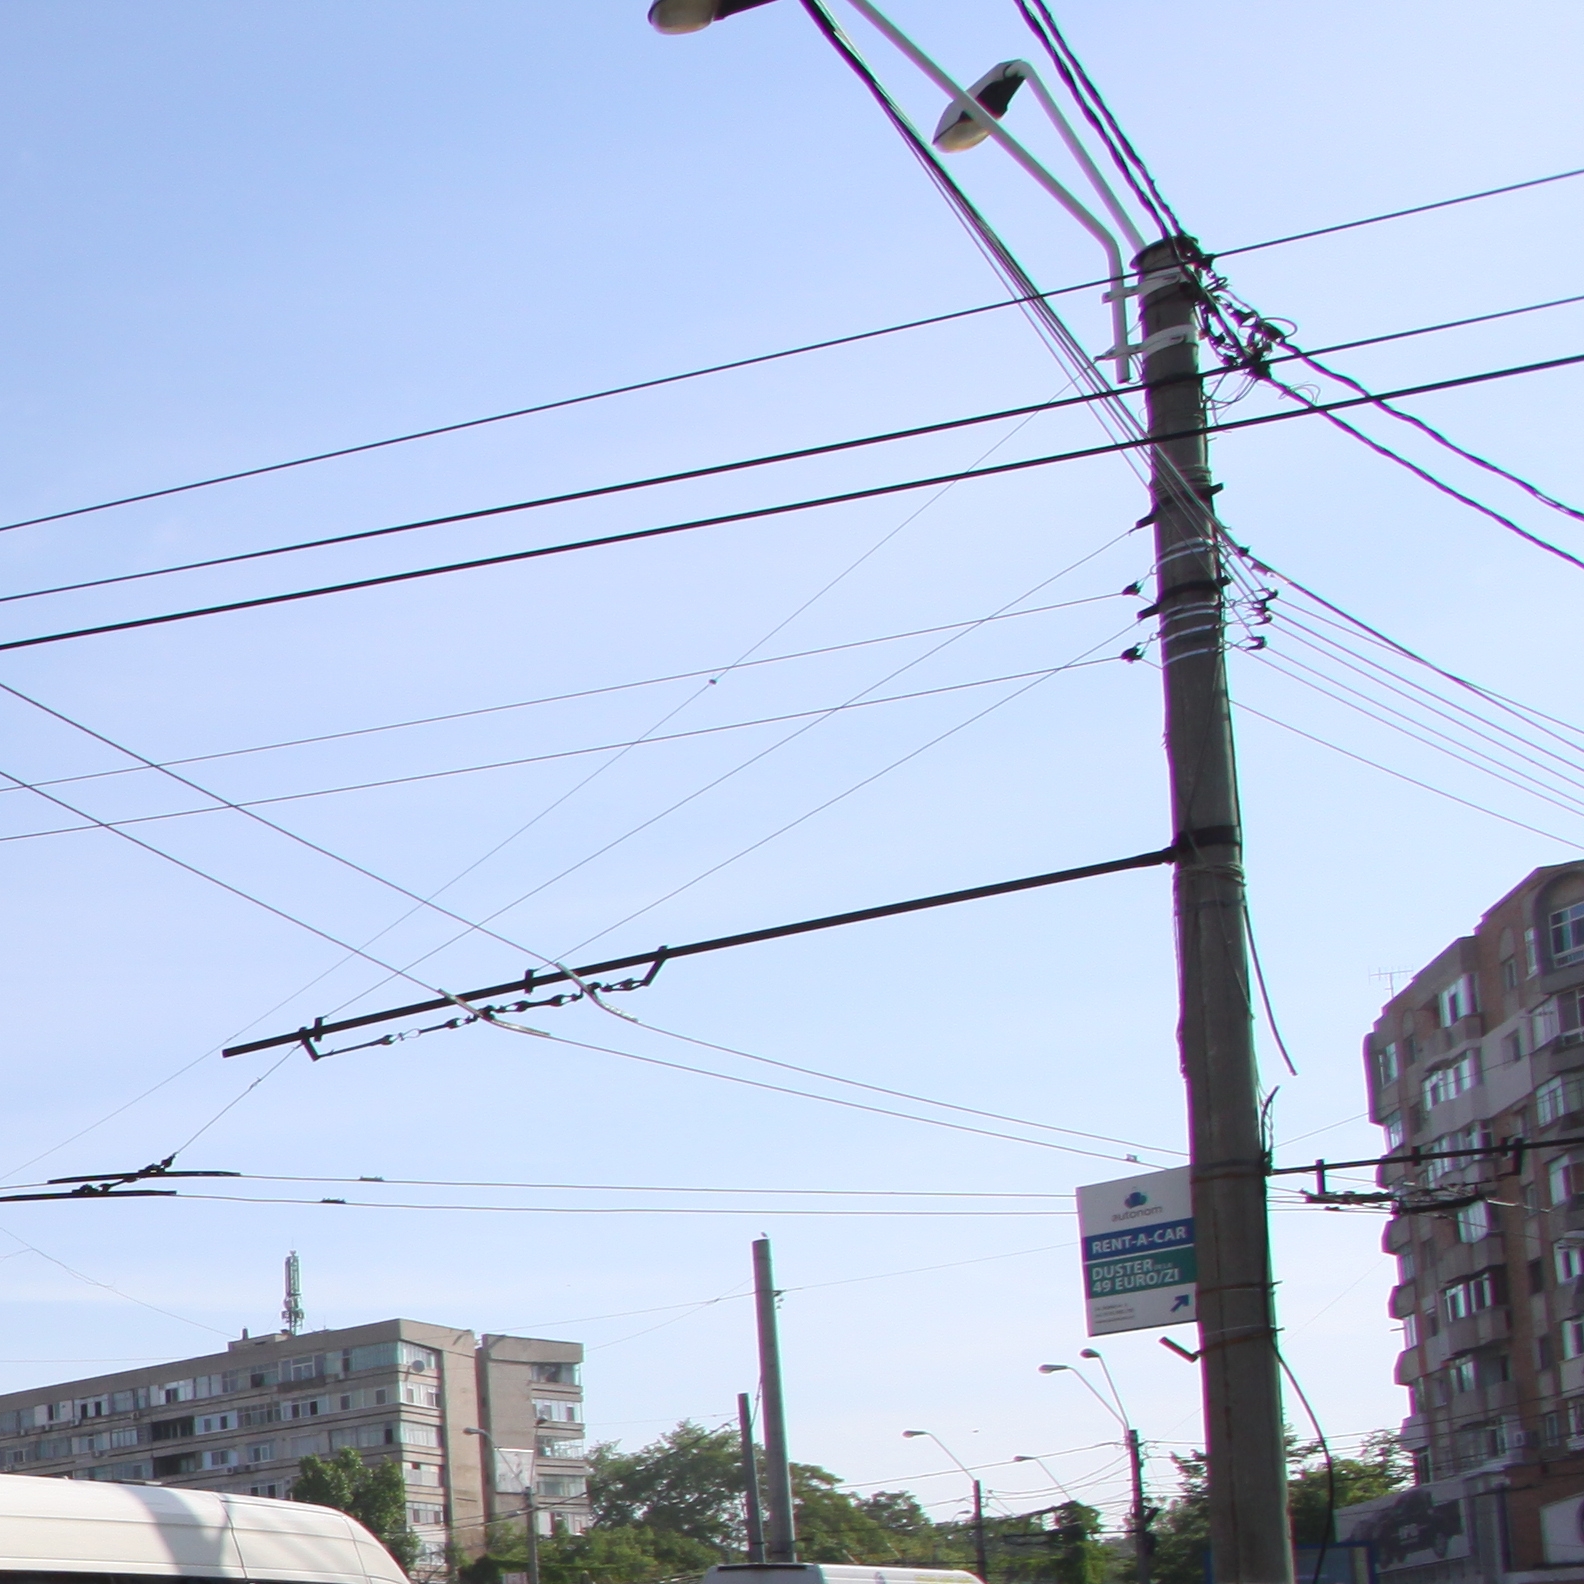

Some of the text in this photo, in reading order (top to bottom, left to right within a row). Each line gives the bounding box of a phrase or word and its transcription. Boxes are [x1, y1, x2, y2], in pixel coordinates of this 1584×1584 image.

[1111, 1206, 1163, 1222] autonom
[1092, 1226, 1186, 1254] RENT-A-CAR
[1092, 1259, 1154, 1281] DUSTER
[1093, 1269, 1179, 1293] 49 EURO/ZI
